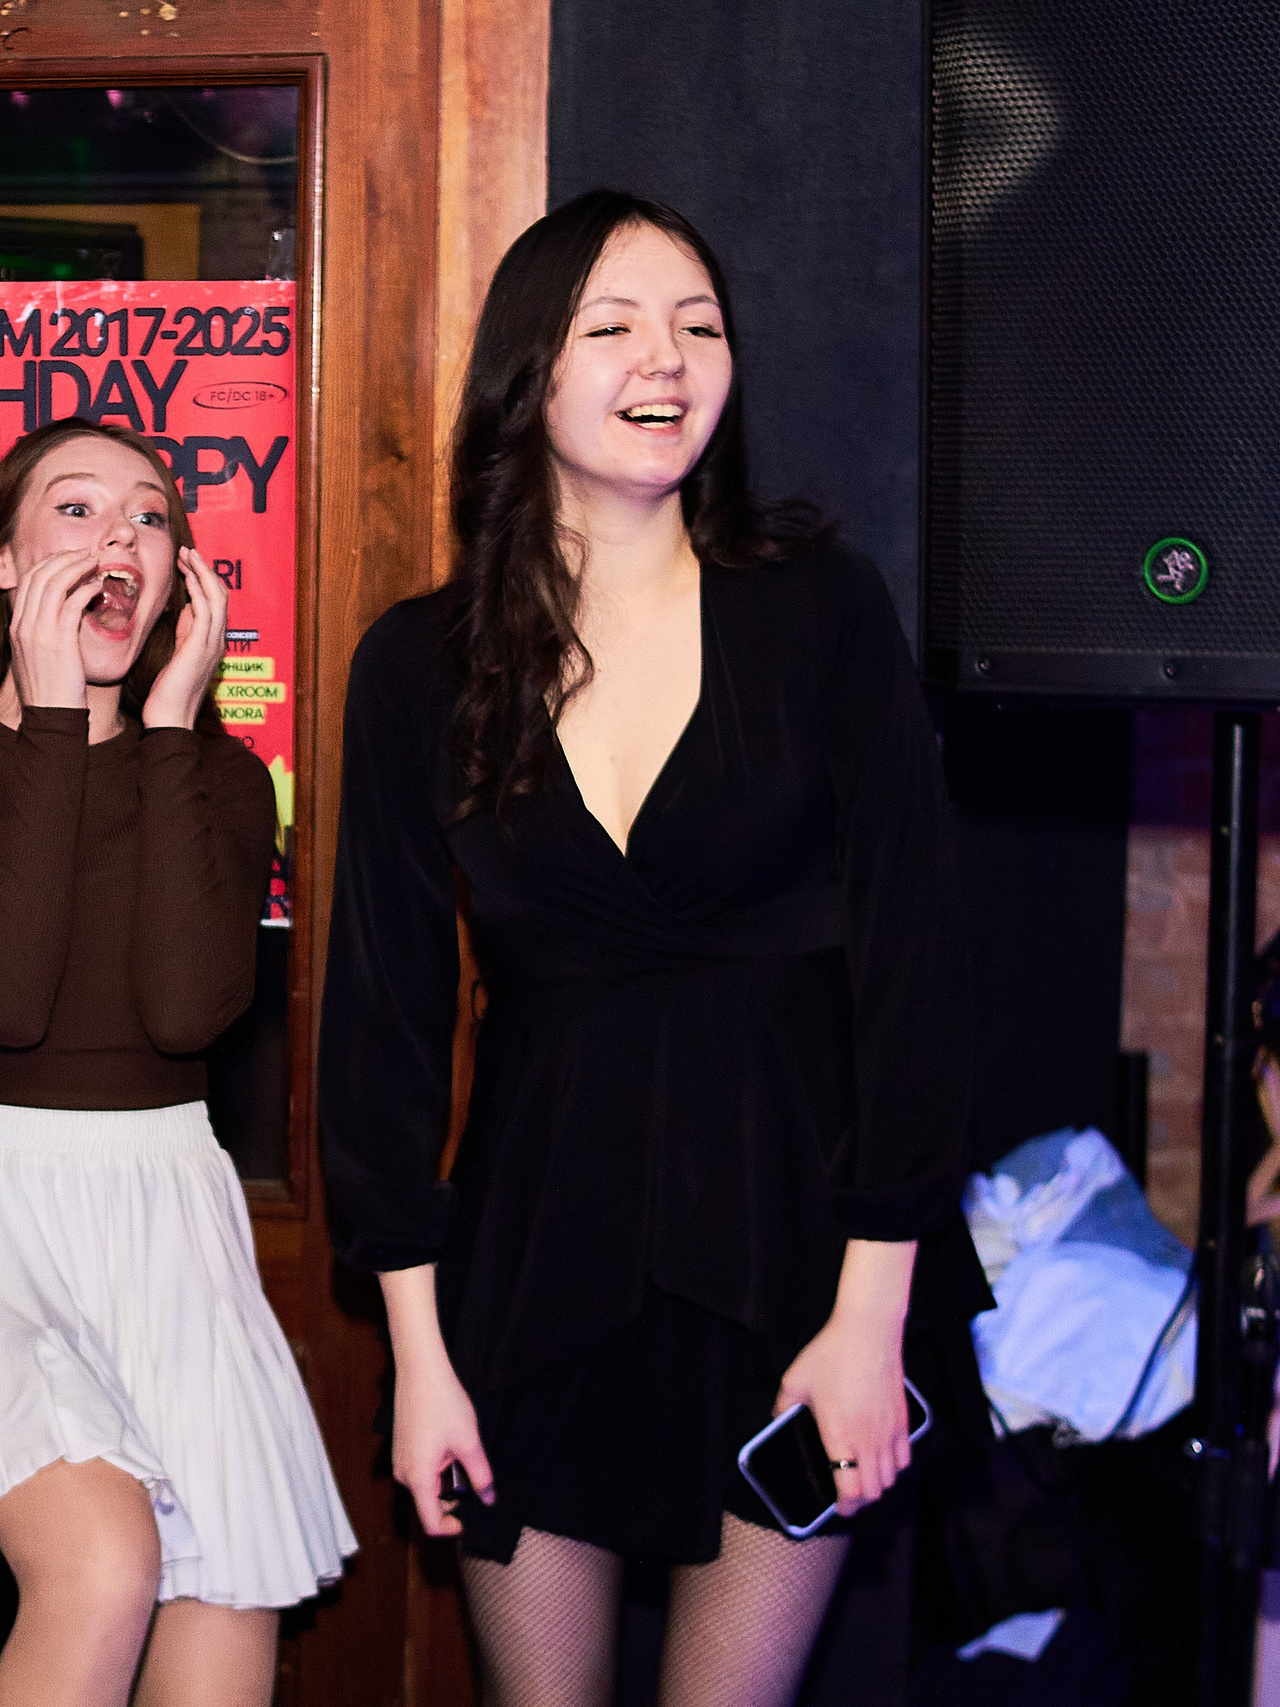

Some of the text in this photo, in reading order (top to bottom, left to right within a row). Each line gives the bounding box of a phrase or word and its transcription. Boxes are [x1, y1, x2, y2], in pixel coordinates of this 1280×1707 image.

[49, 306, 291, 357] 2017-2025
[210, 389, 251, 403] FC/DC
[227, 686, 278, 698] XROOM
